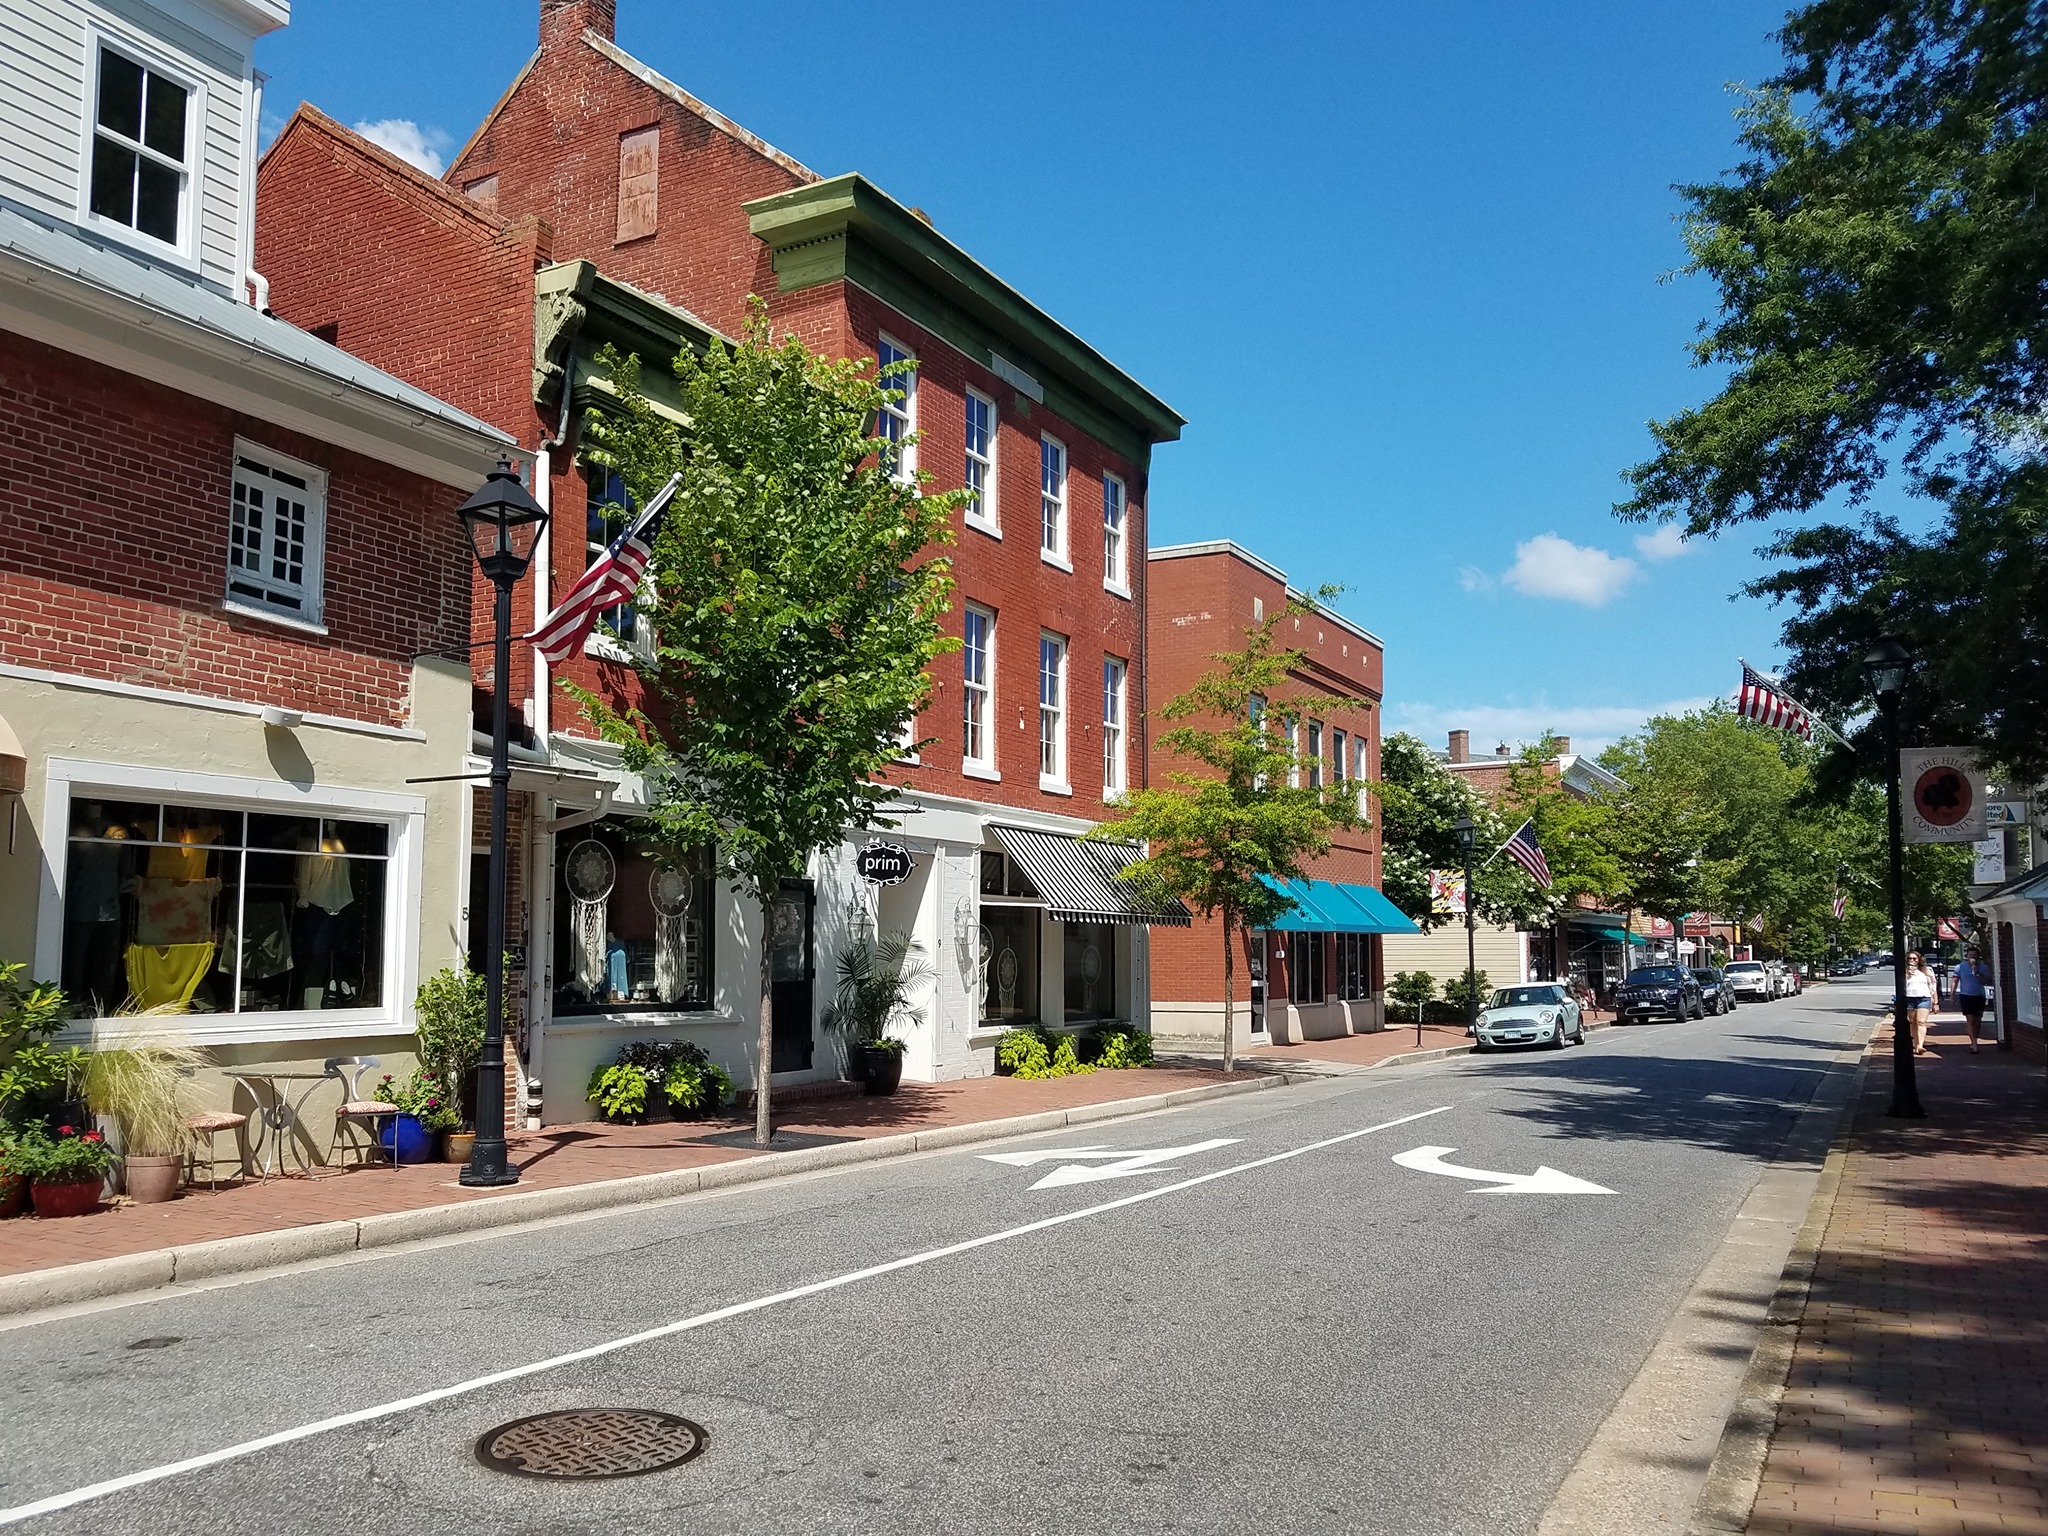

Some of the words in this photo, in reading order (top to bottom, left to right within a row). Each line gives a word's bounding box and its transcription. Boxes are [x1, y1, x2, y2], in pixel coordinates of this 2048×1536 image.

[1916, 757, 1939, 772] THE
[1942, 756, 1966, 772] HILL
[1913, 815, 1975, 835] COMMUNITY
[865, 854, 901, 872] prim
[462, 907, 469, 922] 5
[937, 938, 942, 949] 9
